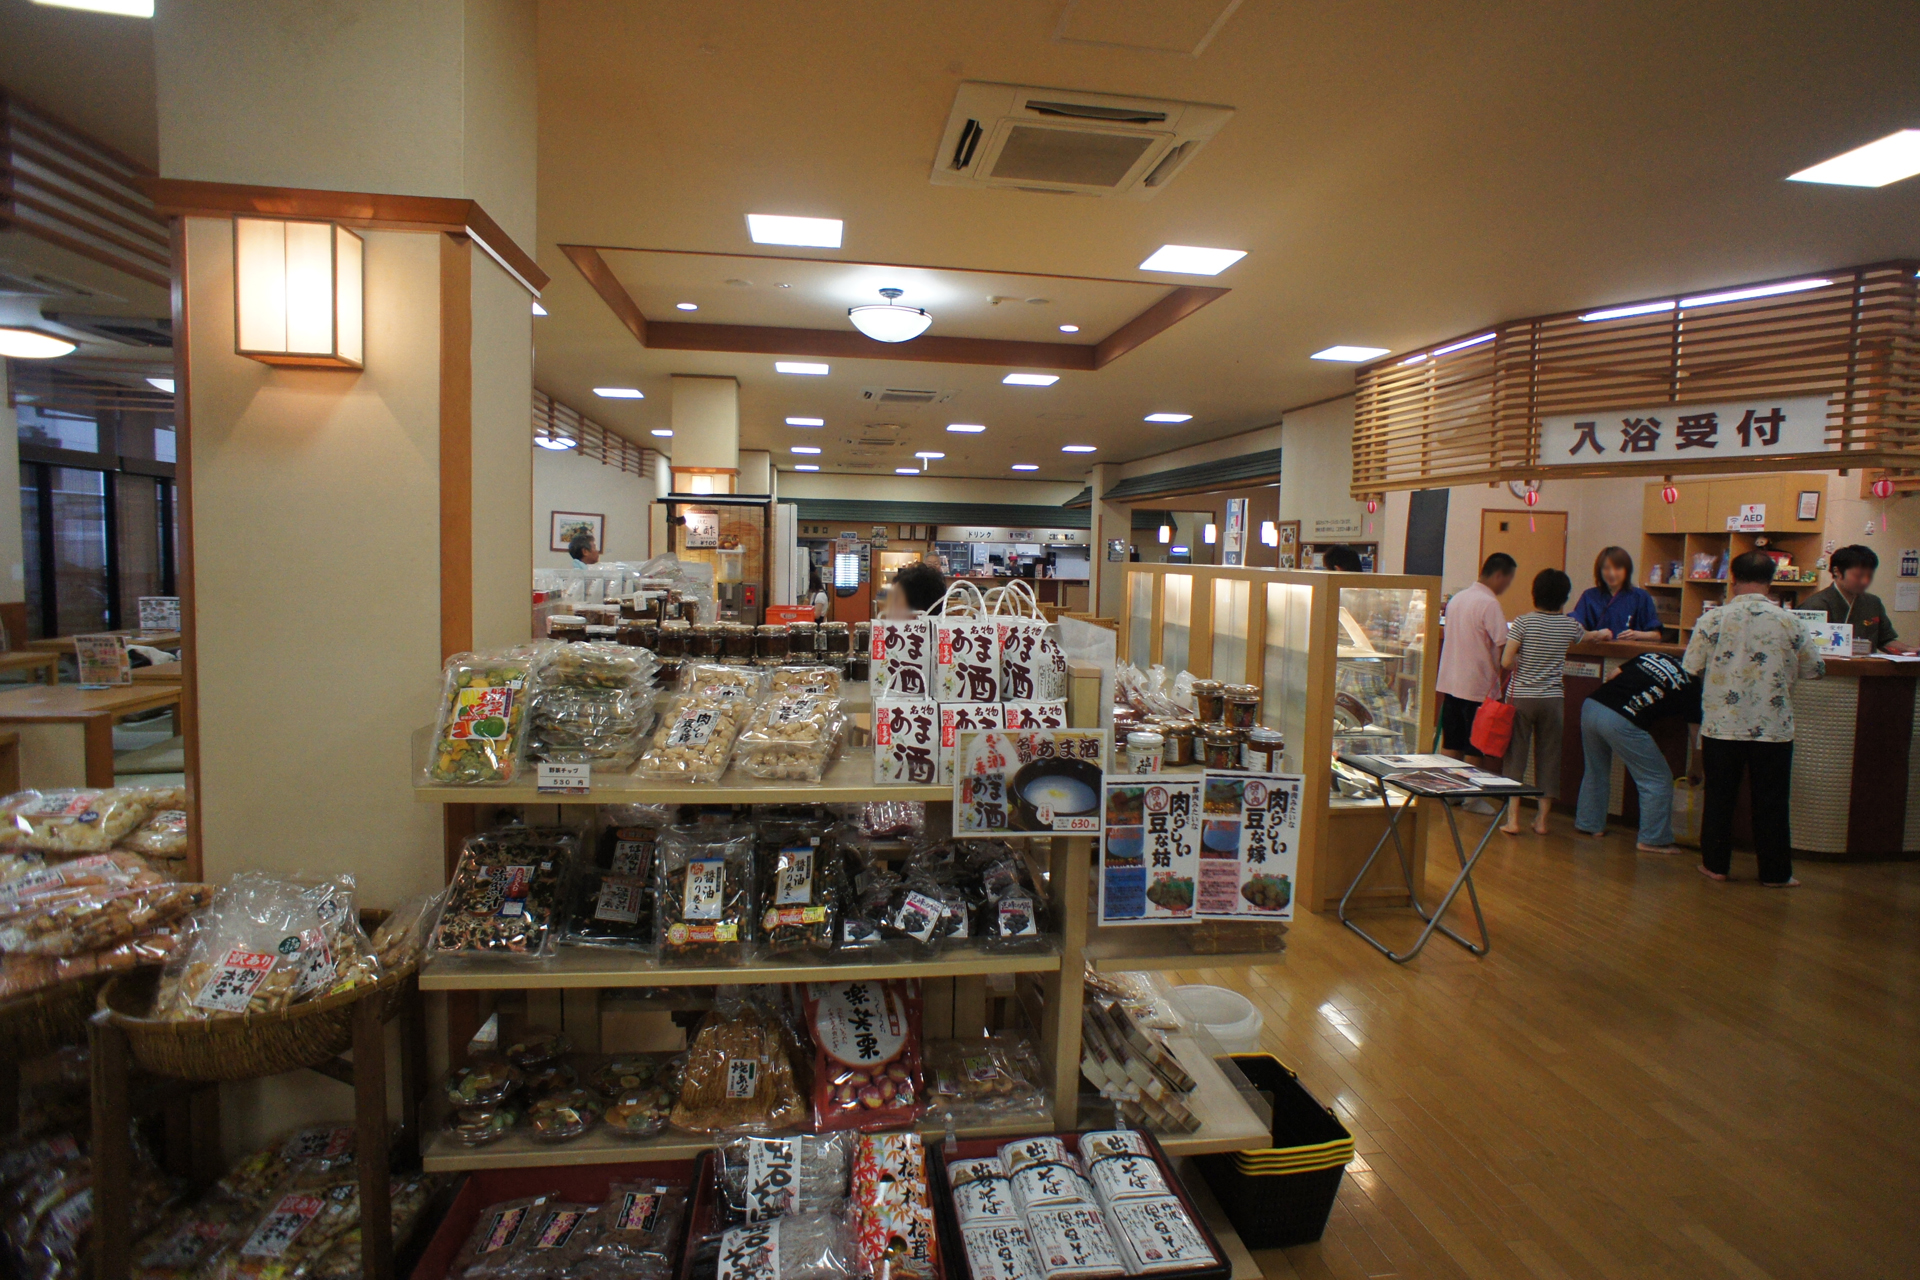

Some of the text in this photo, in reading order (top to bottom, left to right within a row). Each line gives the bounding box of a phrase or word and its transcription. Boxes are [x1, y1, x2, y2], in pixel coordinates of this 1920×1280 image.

[1568, 407, 1786, 456] 入浴受付
[1743, 514, 1763, 522] AED
[689, 525, 717, 536] 黒酢
[968, 531, 992, 539] ドリンク
[903, 624, 927, 634] 名物
[970, 625, 994, 635] 名物
[1022, 625, 1042, 635] 名物
[1642, 661, 1668, 681] MAKAHA
[910, 704, 934, 716] 名物
[975, 706, 999, 717] 名物
[1038, 706, 1062, 717] 名物
[1016, 738, 1032, 764] 名物
[1036, 738, 1100, 759] あま酒
[1169, 790, 1191, 857] 肉らしい
[1267, 788, 1288, 855] 肉らしい
[1148, 811, 1171, 868] 豆な姑
[1244, 807, 1268, 865] 豆な嫁
[794, 860, 805, 886] 醤油
[692, 876, 702, 914] のり巻き
[702, 870, 715, 900] 醤油
[229, 953, 272, 967] 訳あり
[842, 983, 881, 1060] 楽笑栗
[1026, 1141, 1064, 1195] 出そば
[1074, 1210, 1095, 1228] 丹波
[1160, 1202, 1182, 1221] 丹波
[906, 1216, 932, 1264] 松茸
[1010, 1226, 1029, 1247] 丹波
[1057, 1211, 1092, 1265] 黒豆そば
[1144, 1203, 1185, 1259] 黒豆そば
